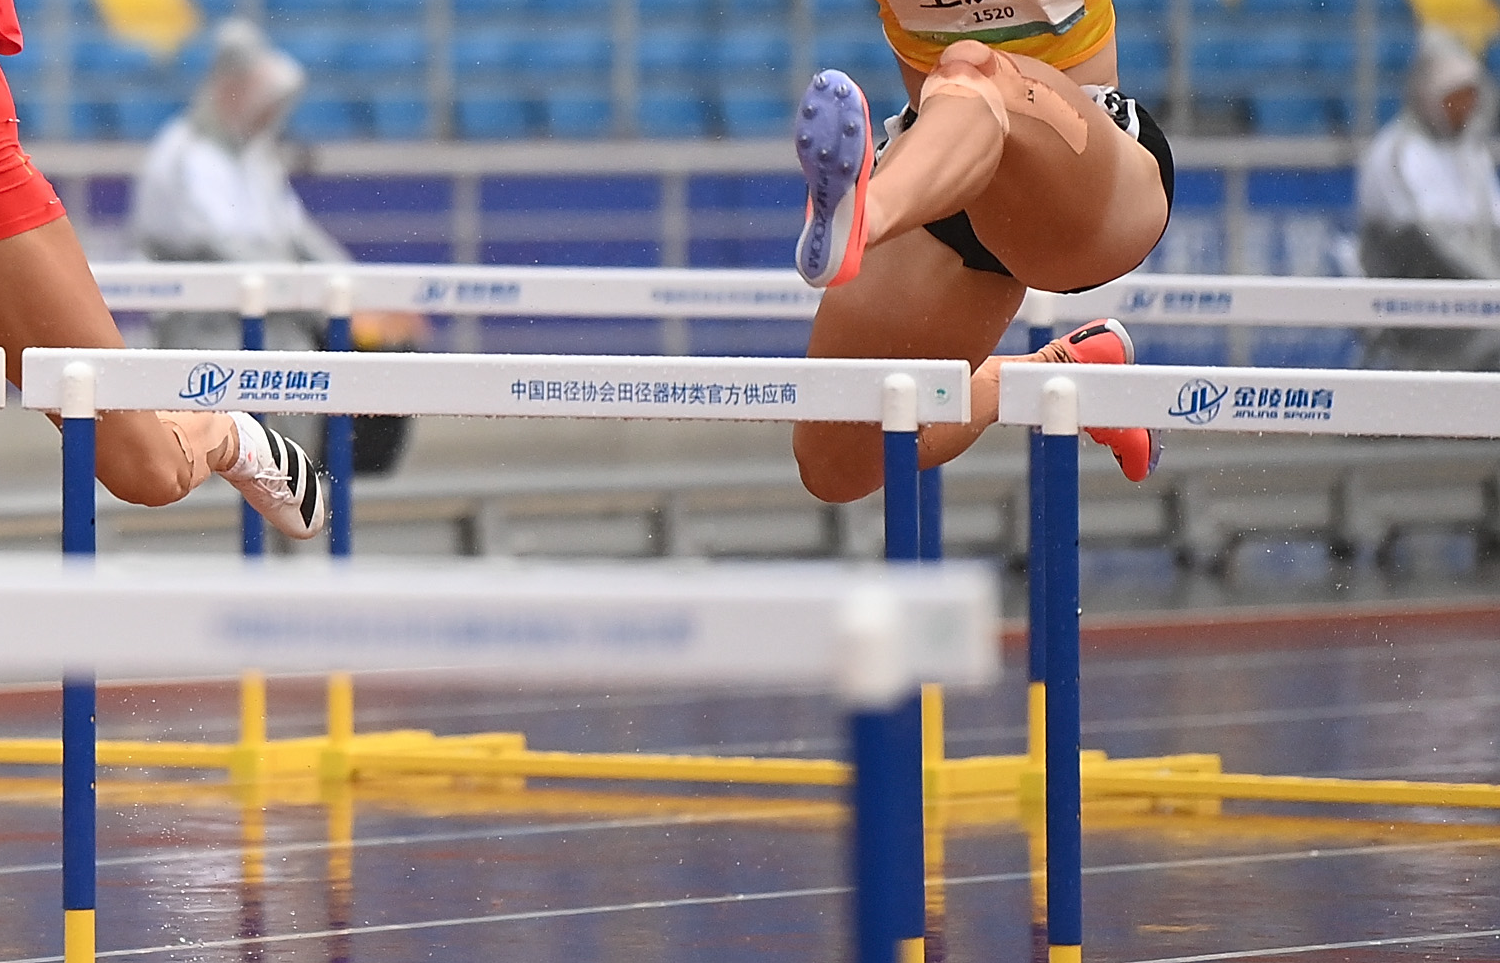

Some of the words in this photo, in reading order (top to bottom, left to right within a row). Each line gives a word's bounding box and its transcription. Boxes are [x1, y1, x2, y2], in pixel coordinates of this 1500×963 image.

[973, 5, 1015, 23] 1520
[238, 369, 331, 390] 金陵体育
[284, 392, 328, 402] SPORTS
[510, 379, 798, 406] 中国田径协会田径器材类官方供应商
[1233, 386, 1335, 410] 金陵体育
